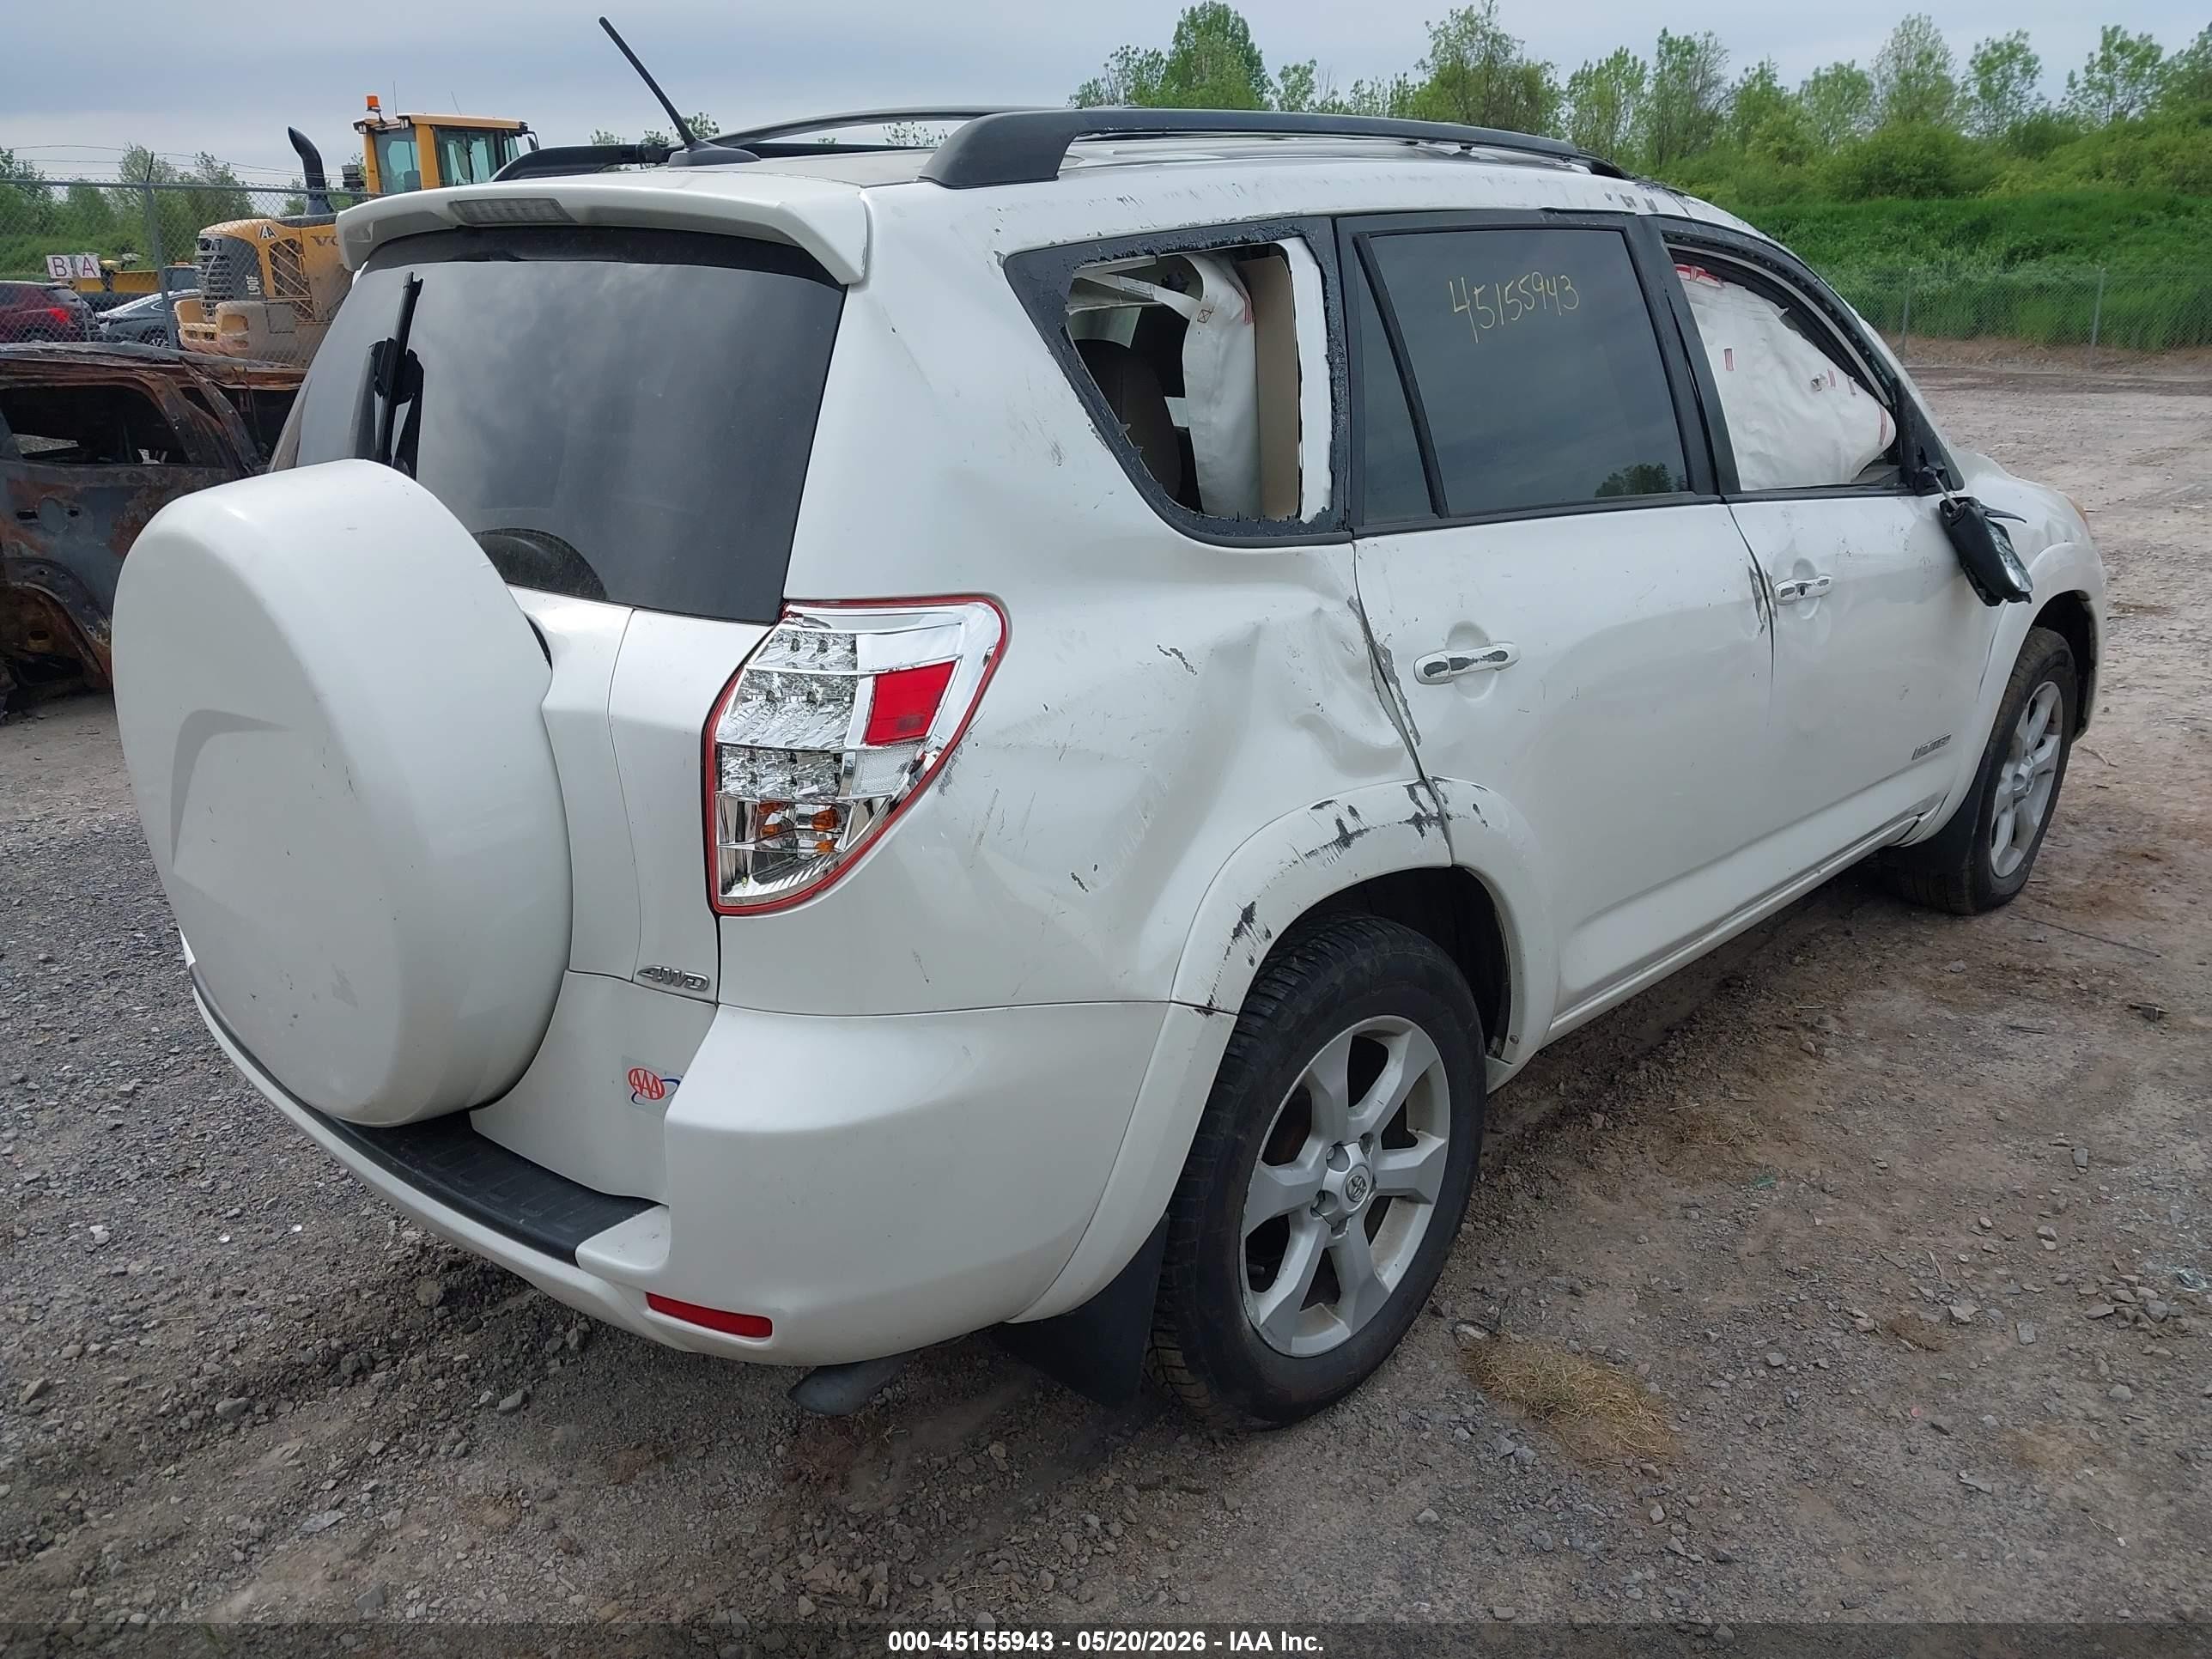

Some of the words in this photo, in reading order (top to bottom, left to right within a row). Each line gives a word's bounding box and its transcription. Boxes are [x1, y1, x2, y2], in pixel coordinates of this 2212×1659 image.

[52, 257, 67, 276] B
[82, 257, 97, 276] A
[246, 274, 261, 295] L90F
[1449, 271, 1579, 343] 45155943
[637, 965, 709, 992] 4WD
[629, 1069, 664, 1100] AAA
